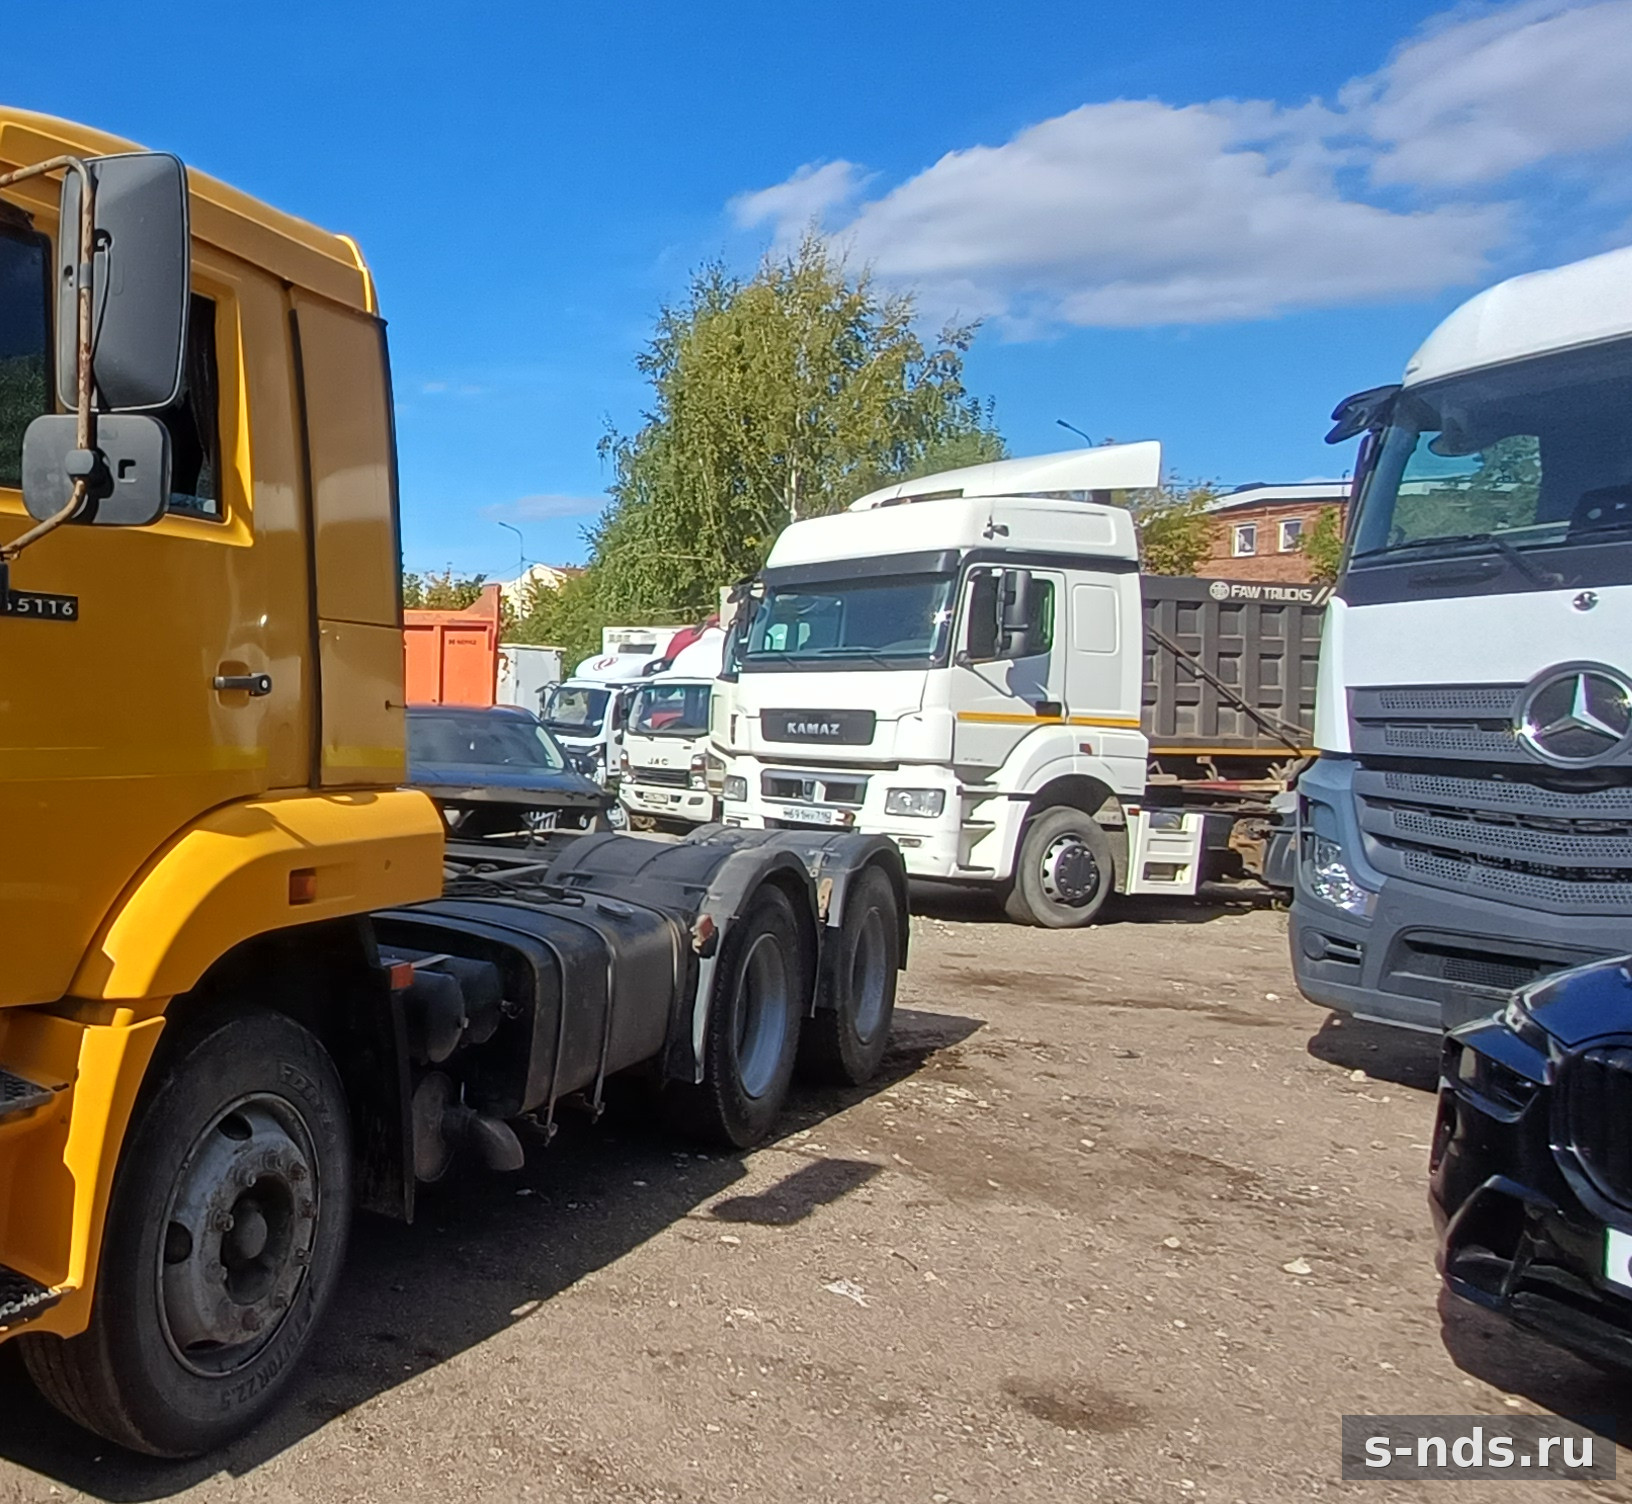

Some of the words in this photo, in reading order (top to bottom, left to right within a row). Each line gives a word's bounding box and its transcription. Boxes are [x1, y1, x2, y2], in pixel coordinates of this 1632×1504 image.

[1231, 585, 1261, 599] FAW
[1263, 587, 1313, 602] TRUCKS
[787, 722, 840, 735] KAMAZ
[648, 758, 669, 766] JAC
